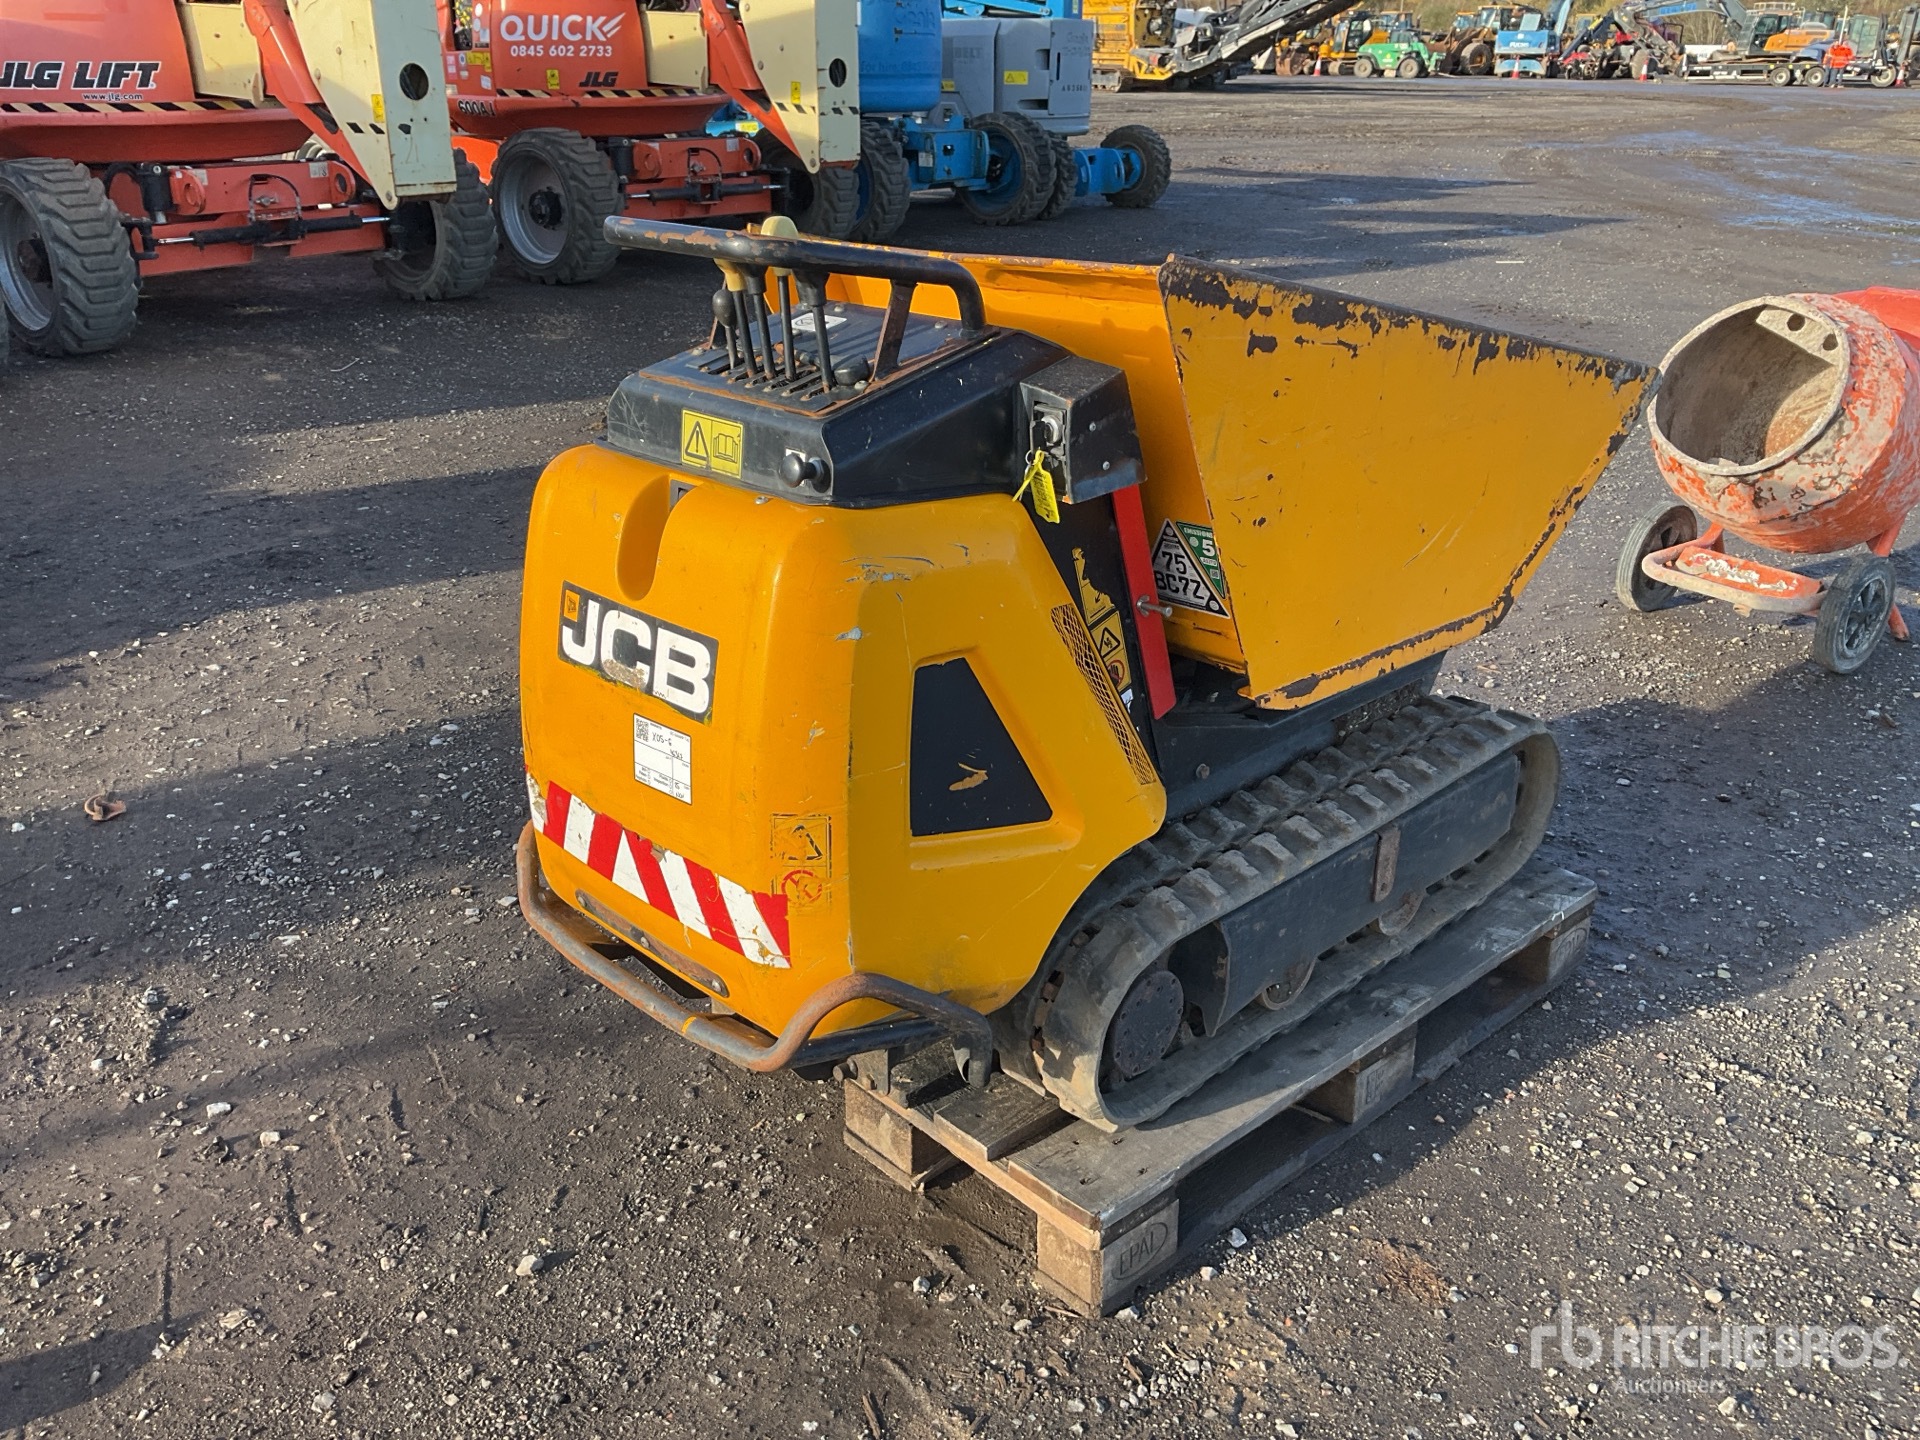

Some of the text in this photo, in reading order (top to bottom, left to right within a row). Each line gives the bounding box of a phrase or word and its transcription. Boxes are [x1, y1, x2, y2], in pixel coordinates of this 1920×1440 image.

[500, 13, 624, 41] QUICK
[510, 45, 613, 57] 0845 602 2733
[0, 61, 161, 90] JLG LIFT
[578, 71, 619, 88] JLG
[82, 92, 144, 102] www.jlg.com
[1202, 538, 1216, 557] 5
[1161, 551, 1187, 575] 75
[561, 599, 712, 714] JCB
